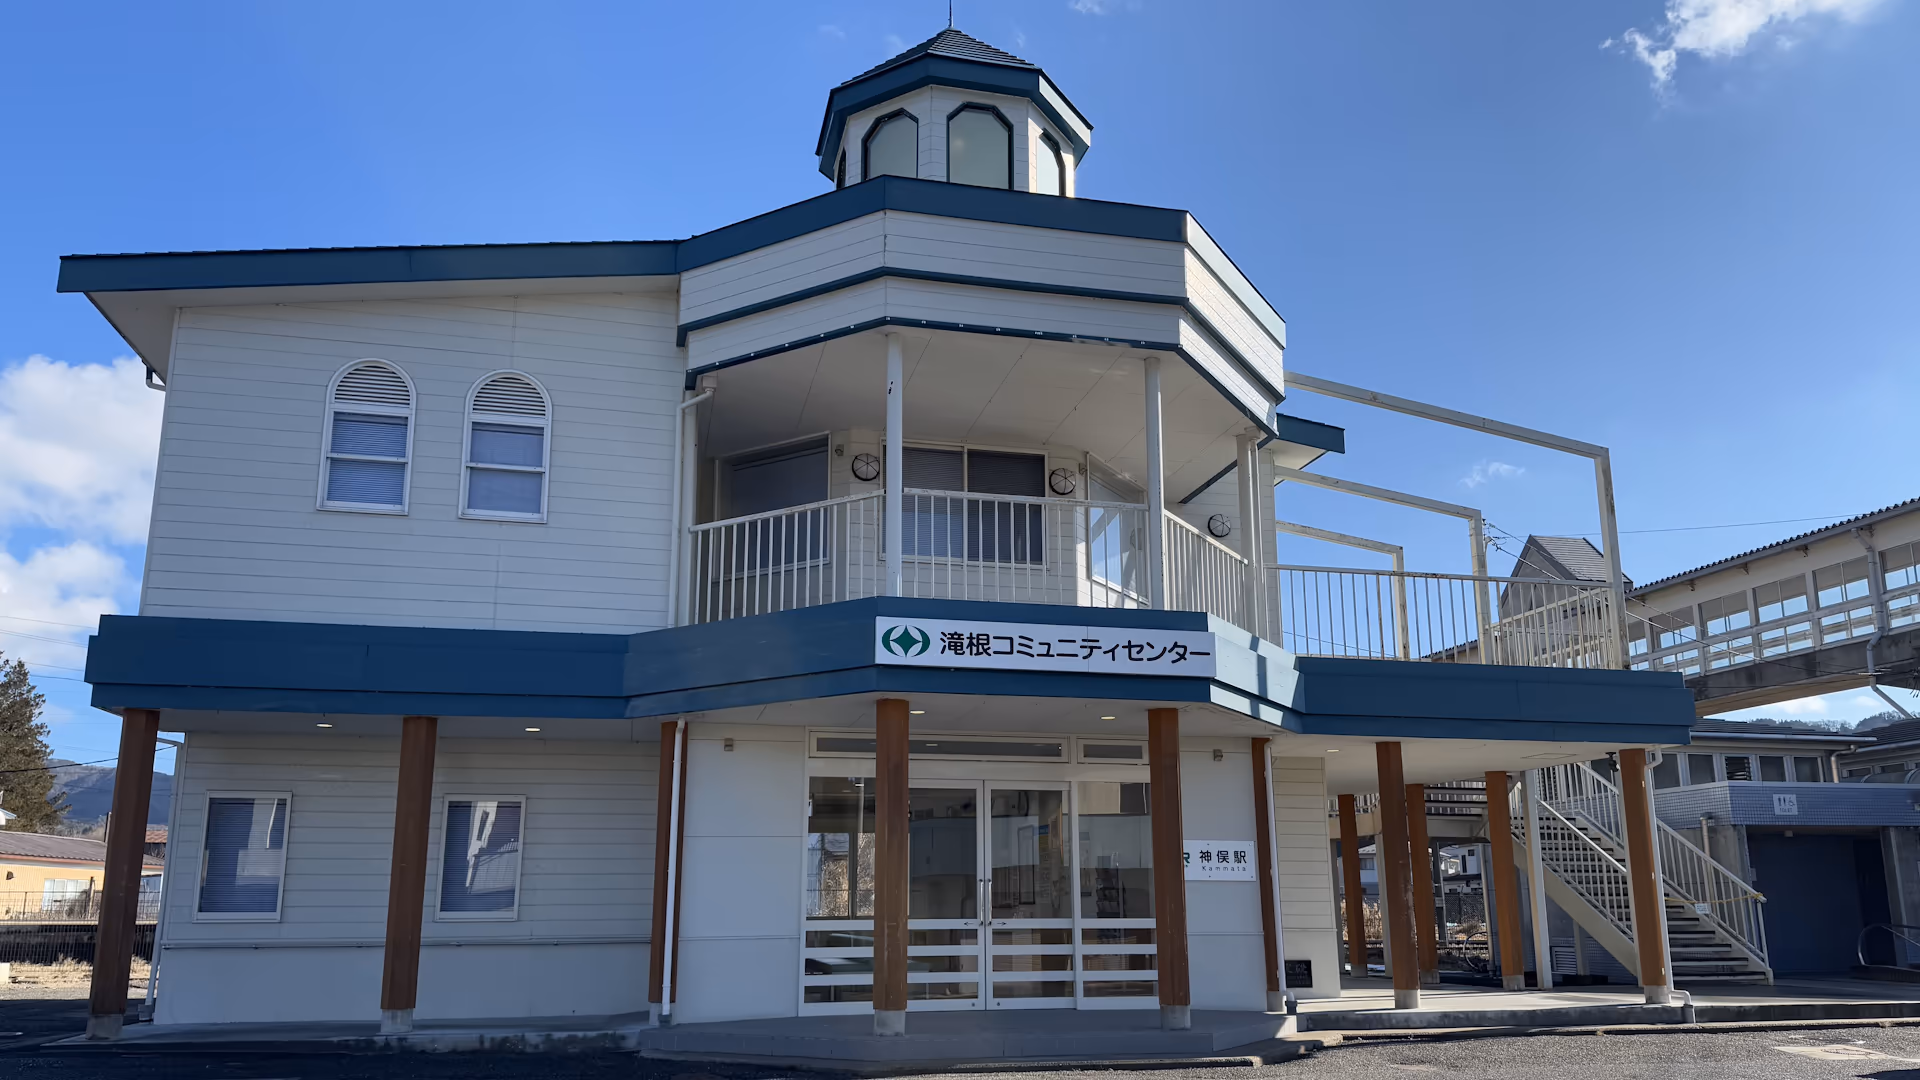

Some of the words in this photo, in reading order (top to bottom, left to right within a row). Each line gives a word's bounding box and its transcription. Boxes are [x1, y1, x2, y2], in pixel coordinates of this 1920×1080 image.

[939, 631, 1211, 664] 滝根コミュニティセンター
[1183, 852, 1191, 864] R
[1199, 850, 1247, 864] 神俣駅
